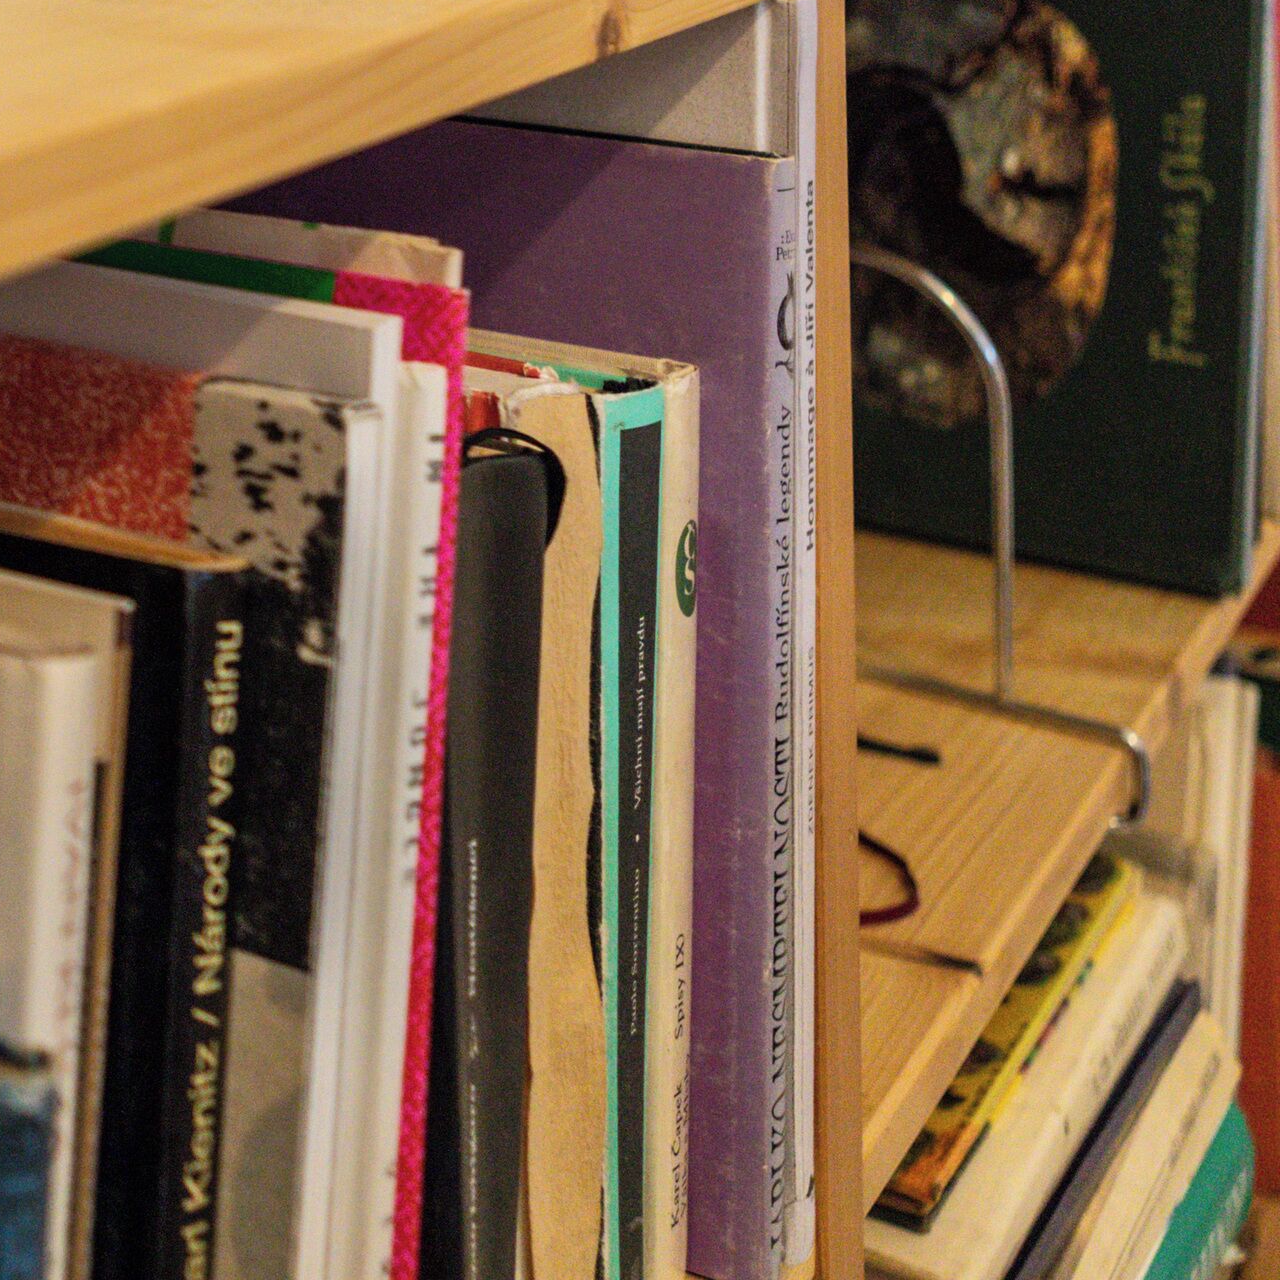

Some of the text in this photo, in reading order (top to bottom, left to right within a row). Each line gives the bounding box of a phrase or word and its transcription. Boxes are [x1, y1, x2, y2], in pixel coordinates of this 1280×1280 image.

[805, 179, 814, 292] Valenta
[804, 304, 814, 348] Jiří
[804, 359, 814, 376] à
[775, 404, 792, 523] legendy
[805, 387, 815, 552] Hommage
[204, 620, 244, 735] stínu
[637, 615, 646, 683] pravdu
[774, 535, 791, 724] Rudolfínské
[208, 746, 234, 807] ve
[191, 817, 236, 994] Národy
[674, 978, 686, 1040] Spisy
[182, 1040, 220, 1213] Kienitz
[670, 1164, 680, 1229] Karel
